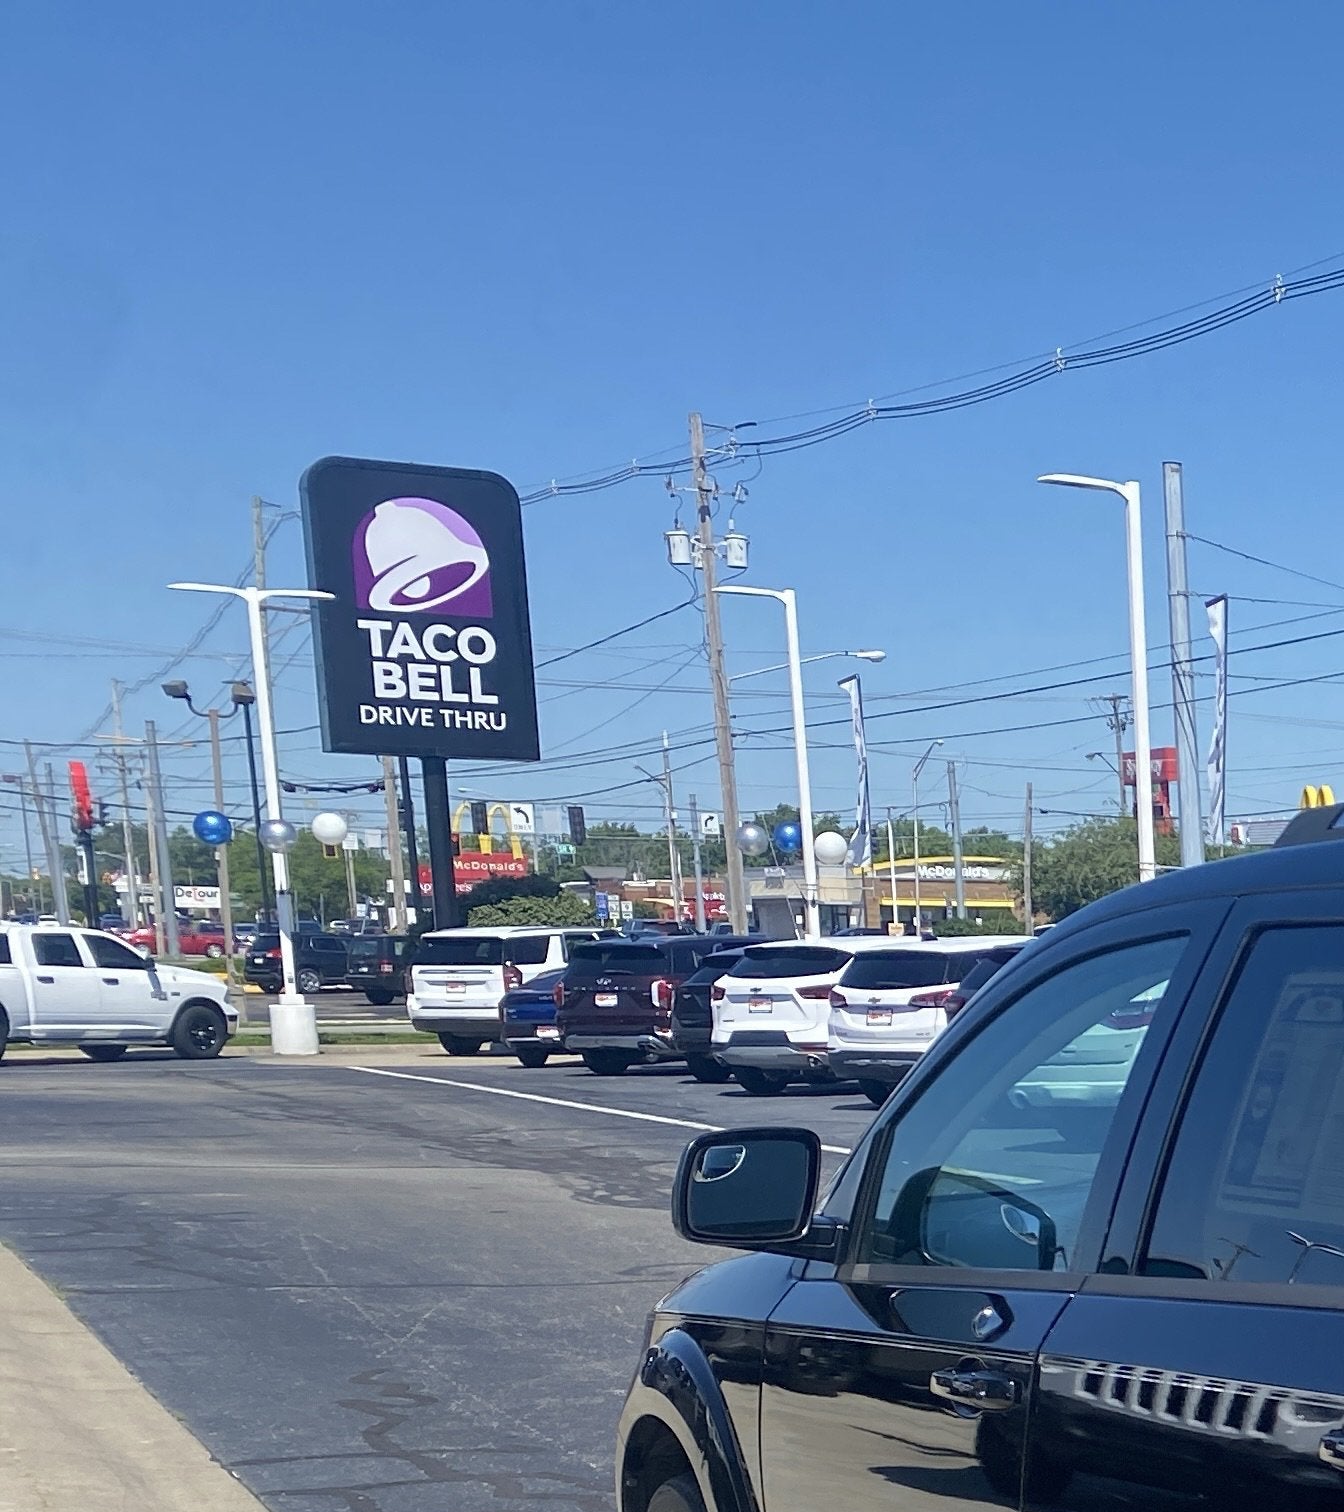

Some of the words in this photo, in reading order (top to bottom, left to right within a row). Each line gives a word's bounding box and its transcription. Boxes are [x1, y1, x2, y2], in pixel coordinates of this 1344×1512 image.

[357, 619, 497, 664] TACO
[372, 661, 499, 705] BELL
[359, 704, 435, 727] DRIVE
[439, 709, 507, 731] THRU
[918, 866, 989, 878] McDoald's
